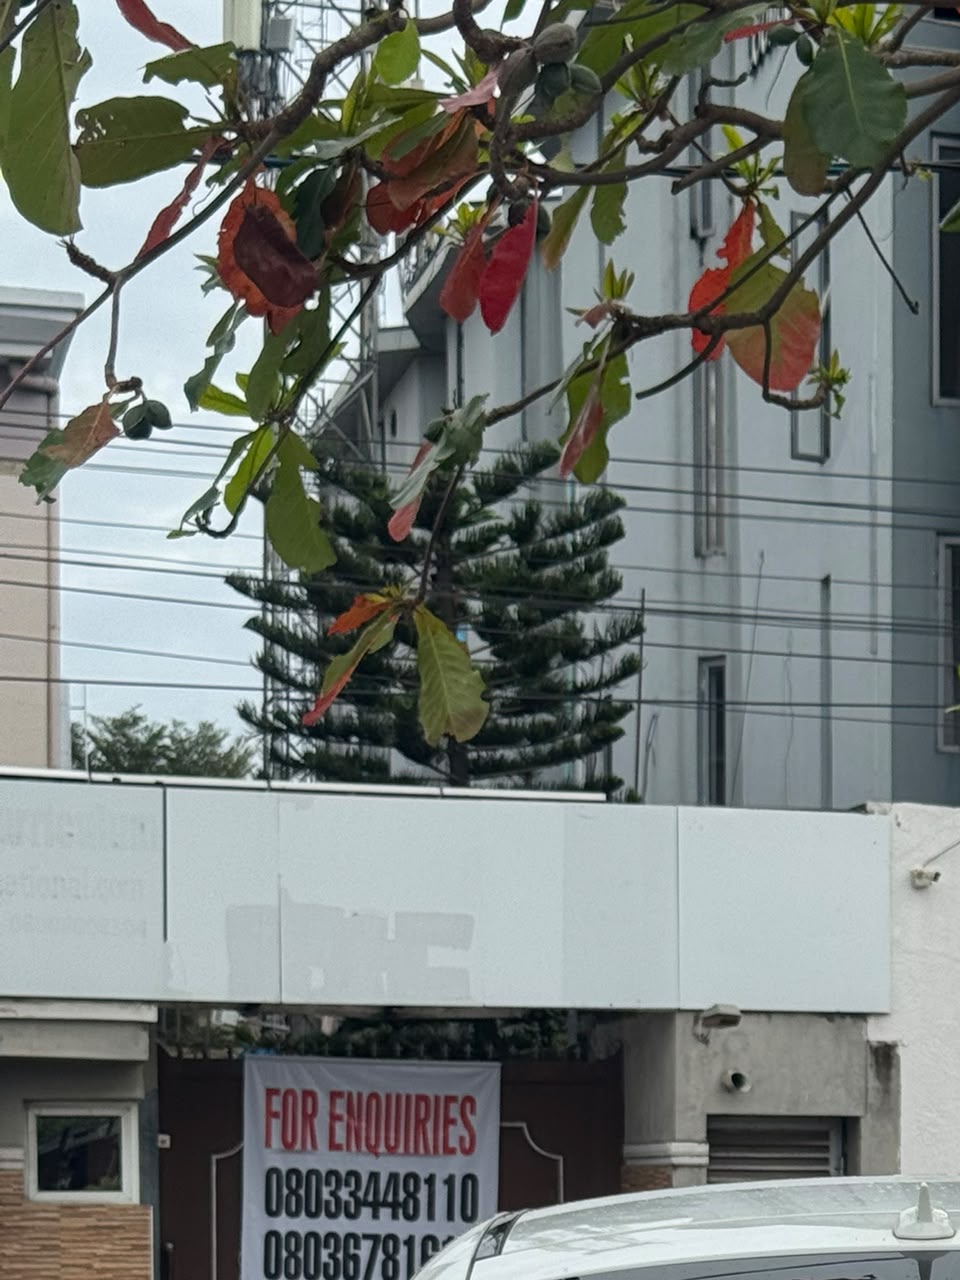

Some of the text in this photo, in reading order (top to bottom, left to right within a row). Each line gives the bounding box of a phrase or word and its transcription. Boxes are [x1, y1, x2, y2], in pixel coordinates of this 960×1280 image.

[264, 1088, 477, 1158] FOR ENQUIRIES
[264, 1167, 480, 1223] 08033448110
